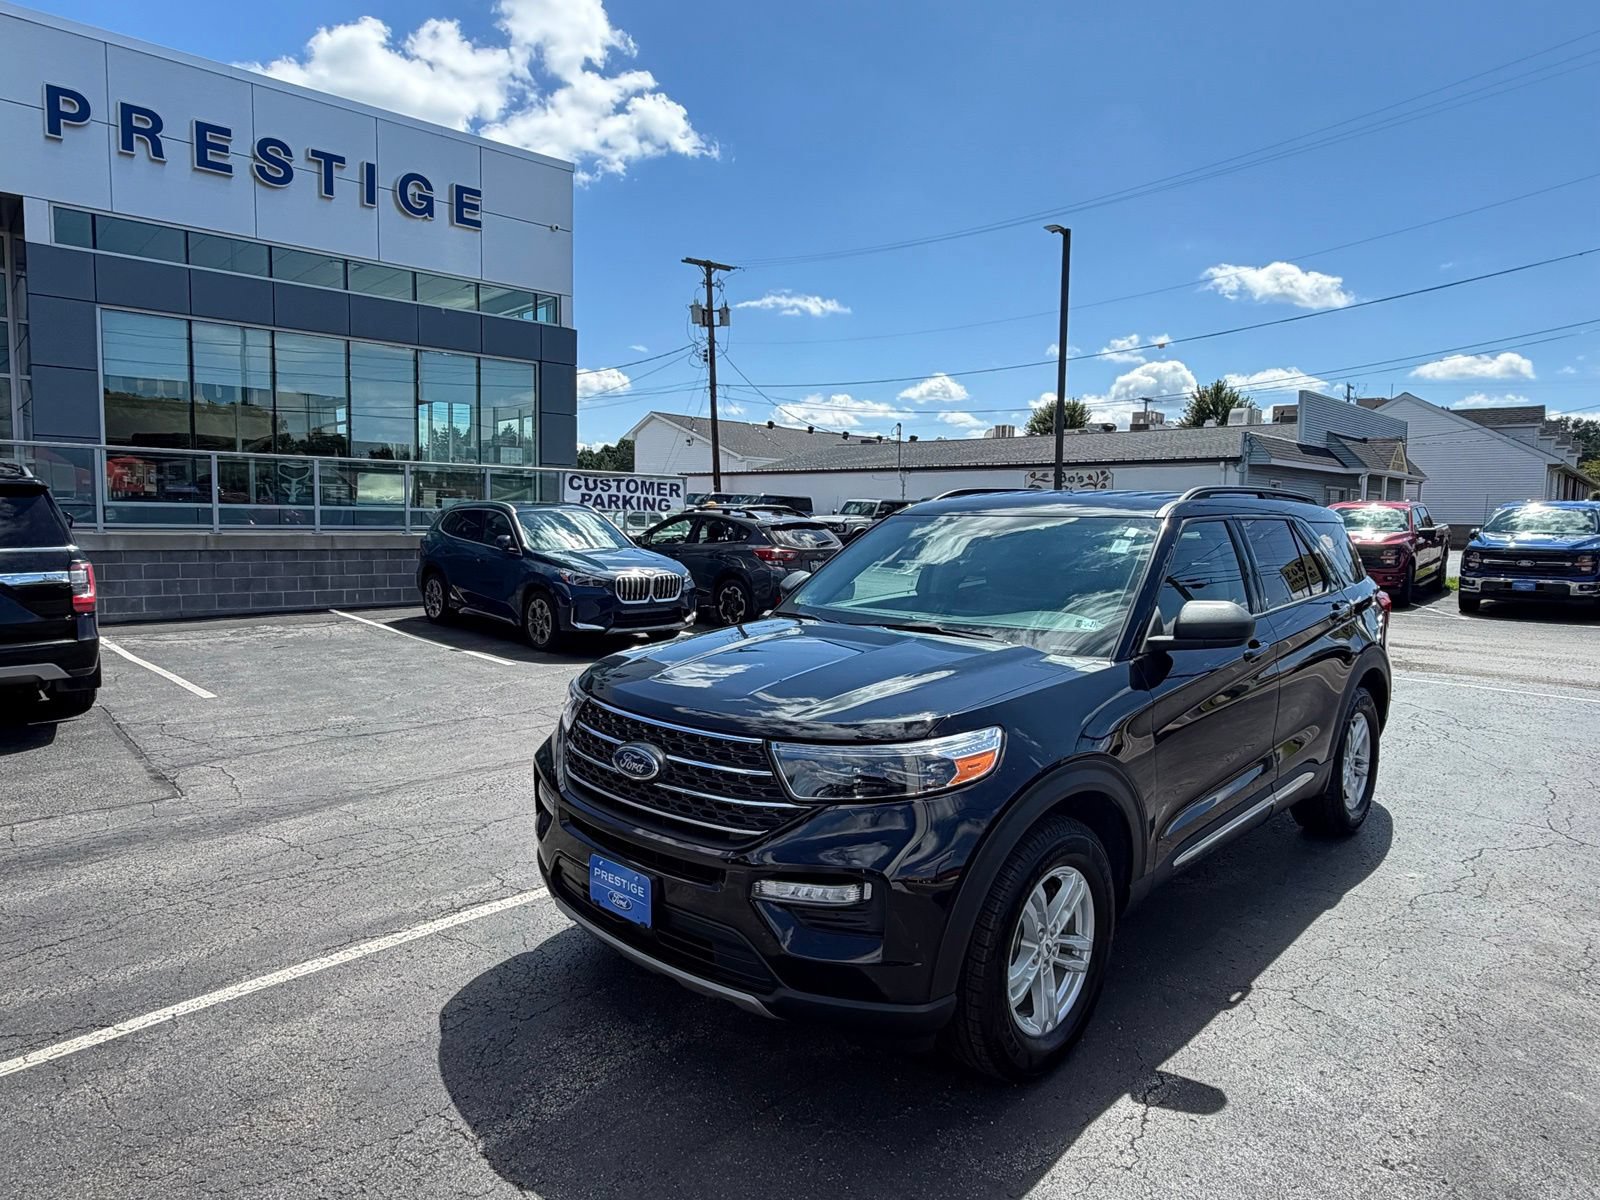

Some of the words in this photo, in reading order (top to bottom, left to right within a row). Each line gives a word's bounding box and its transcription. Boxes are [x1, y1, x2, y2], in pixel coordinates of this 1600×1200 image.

[43, 81, 482, 231] PRESTIGE
[568, 475, 682, 498] CUSTOMER
[580, 493, 671, 512] PARKING
[619, 752, 646, 774] Ford
[594, 867, 645, 898] PRESTIGE
[611, 892, 628, 908] Ford
